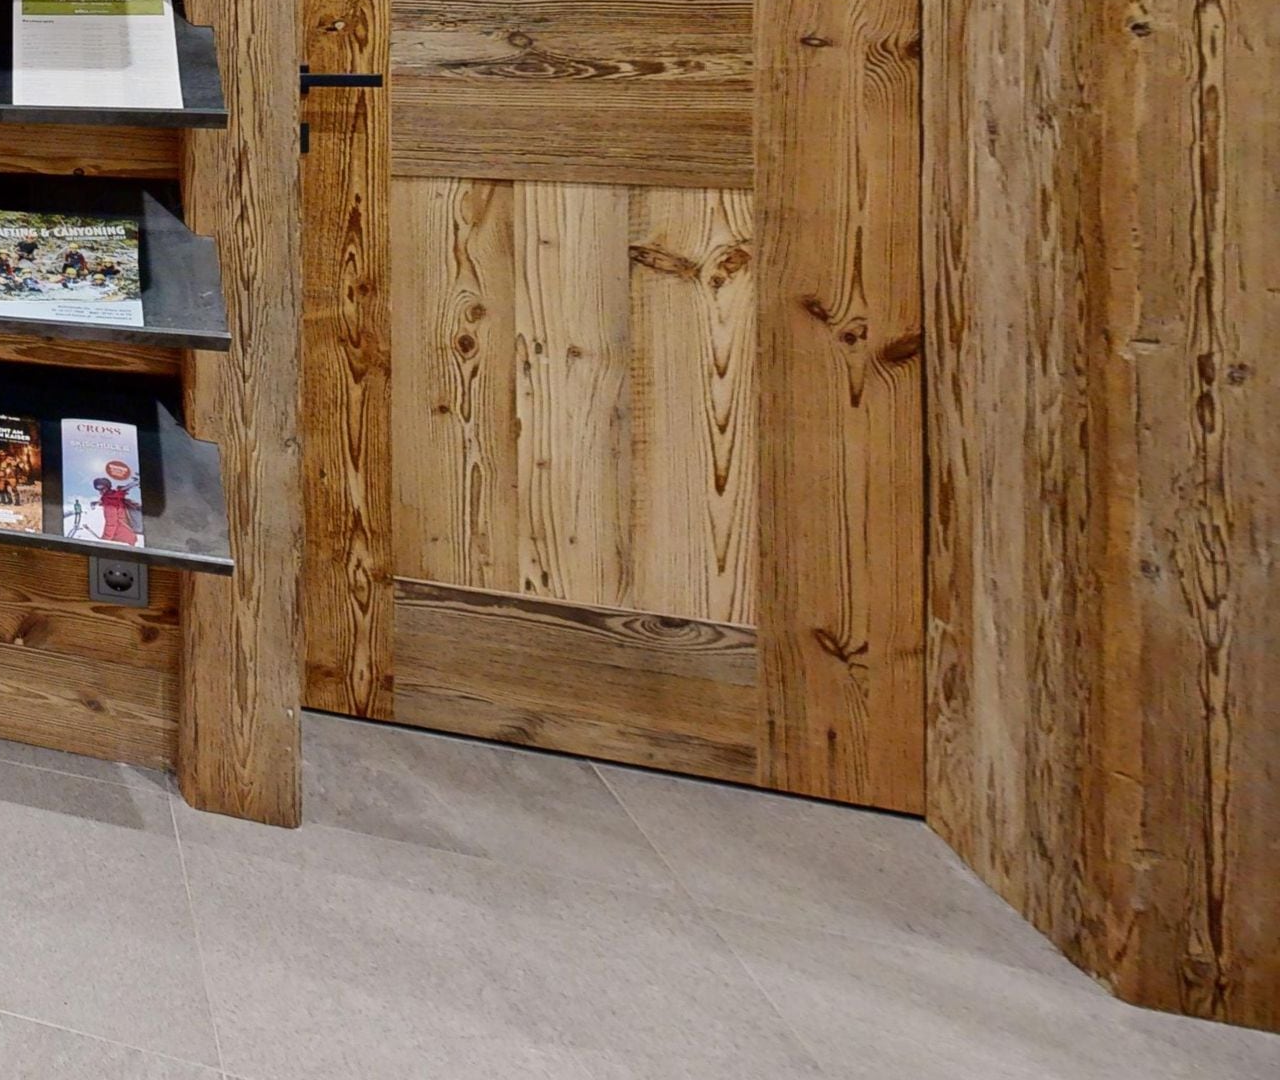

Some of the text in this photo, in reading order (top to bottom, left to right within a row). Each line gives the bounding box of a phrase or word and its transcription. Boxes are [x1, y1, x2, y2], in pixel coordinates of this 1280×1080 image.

[40, 228, 49, 237] &
[53, 225, 125, 237] CANYONING
[76, 424, 122, 434] CROSS
